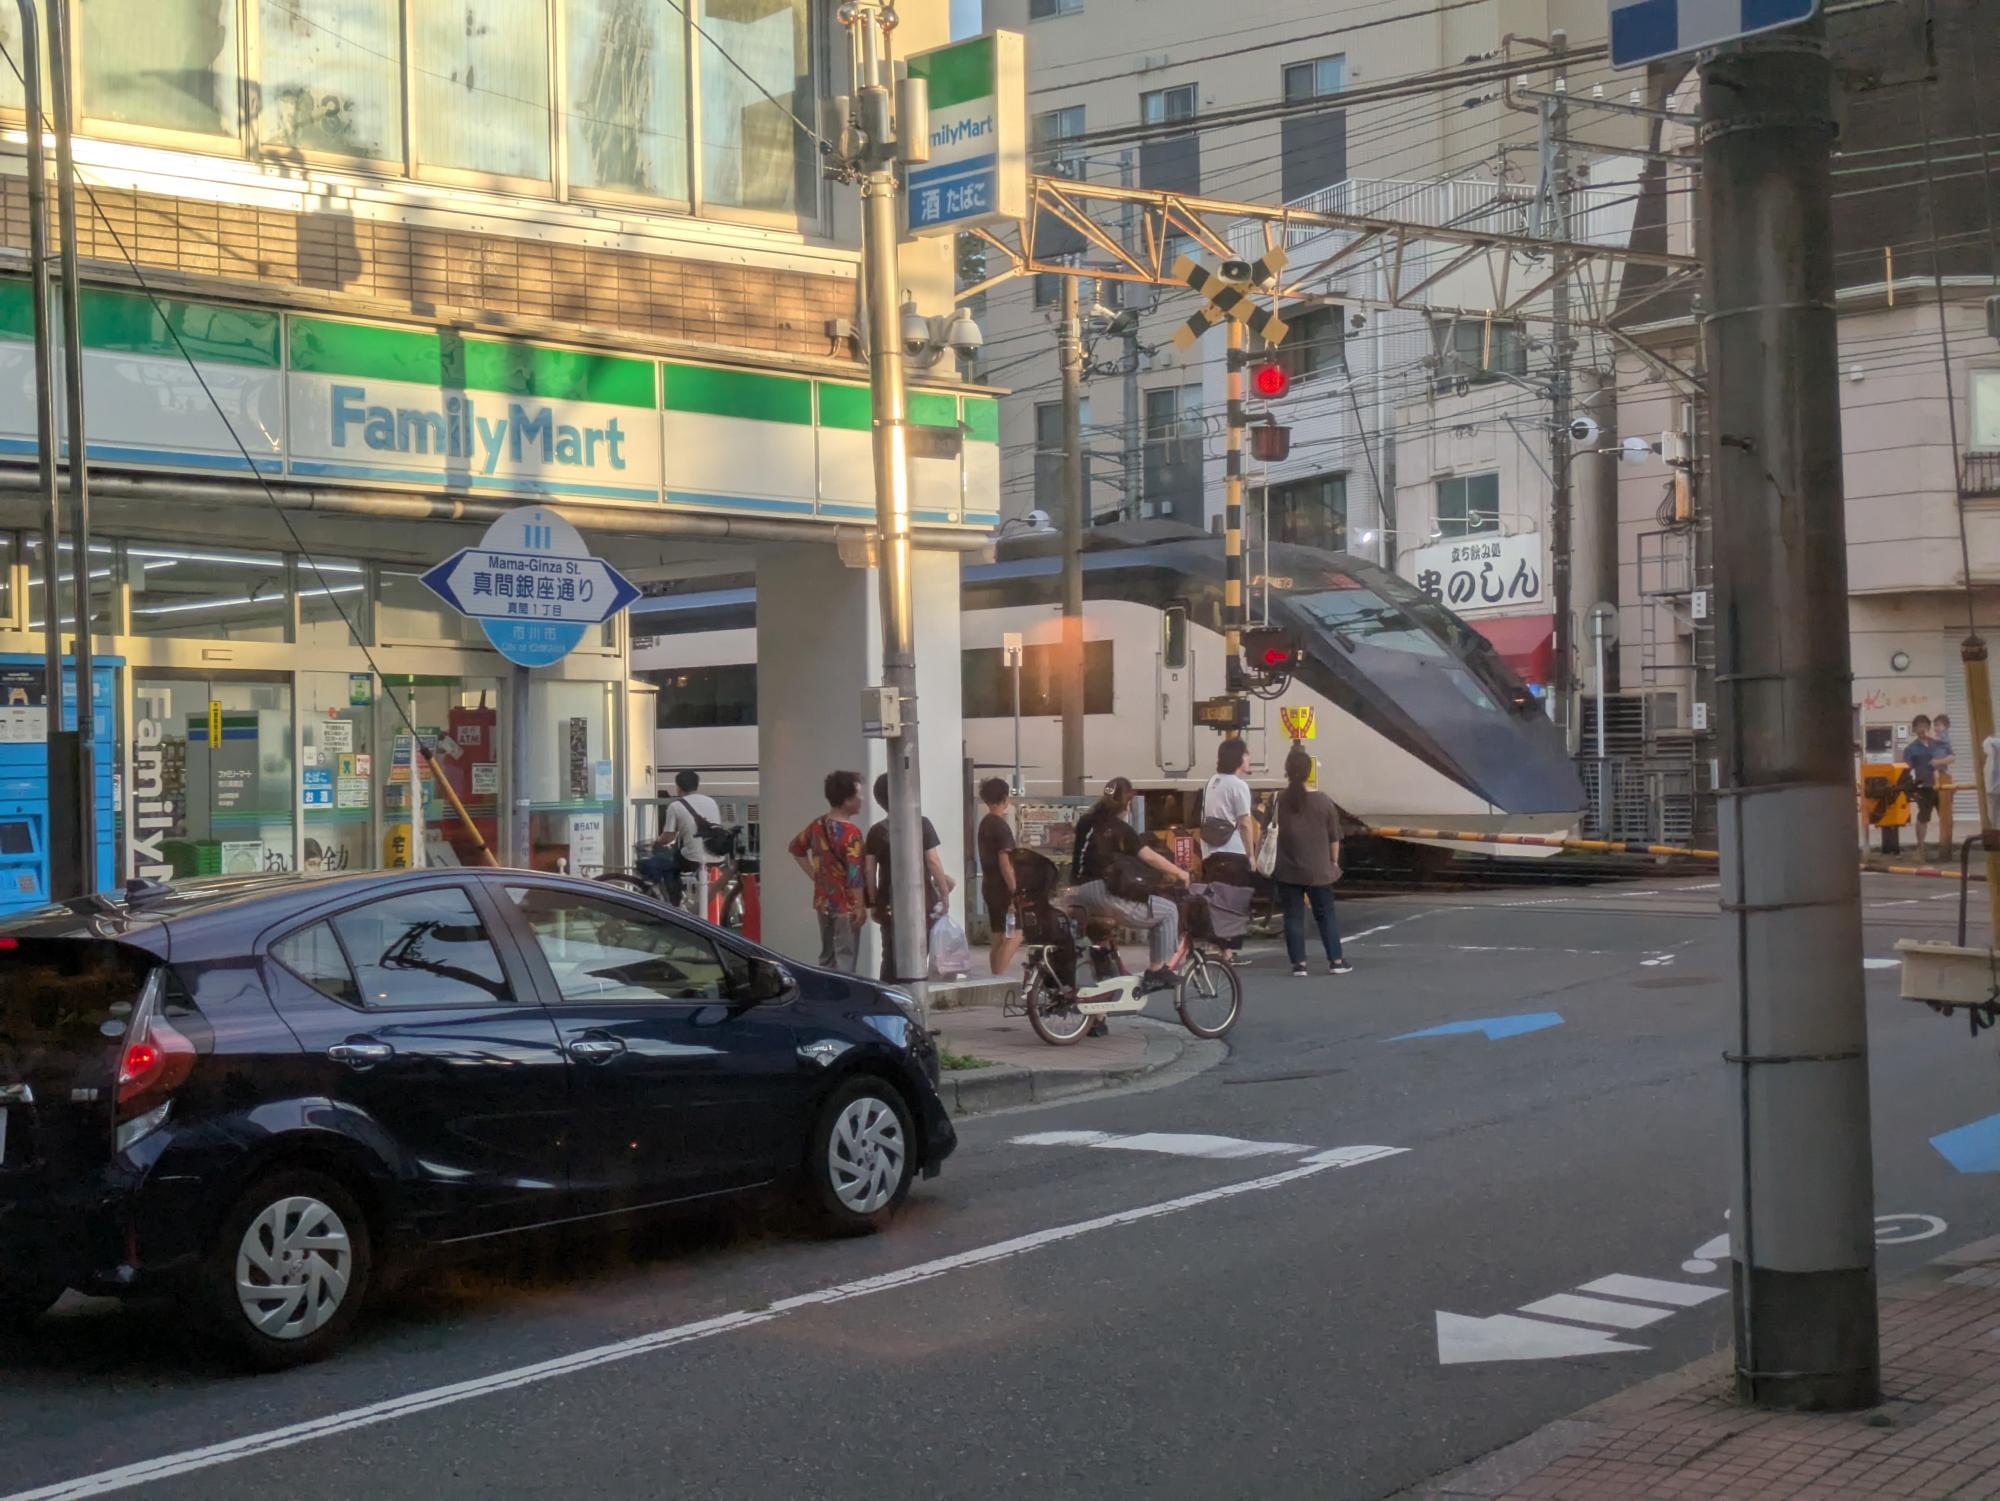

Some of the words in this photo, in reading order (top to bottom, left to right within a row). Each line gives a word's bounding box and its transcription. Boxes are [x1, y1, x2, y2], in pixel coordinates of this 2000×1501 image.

[922, 188, 940, 220] 酒
[947, 182, 985, 213] たばこ
[330, 384, 626, 474] FamilyMart
[488, 556, 562, 574] Mama-Ginza
[566, 561, 581, 575] St.
[1417, 557, 1539, 605] 串のしん
[473, 571, 593, 602] 真間銀座通り
